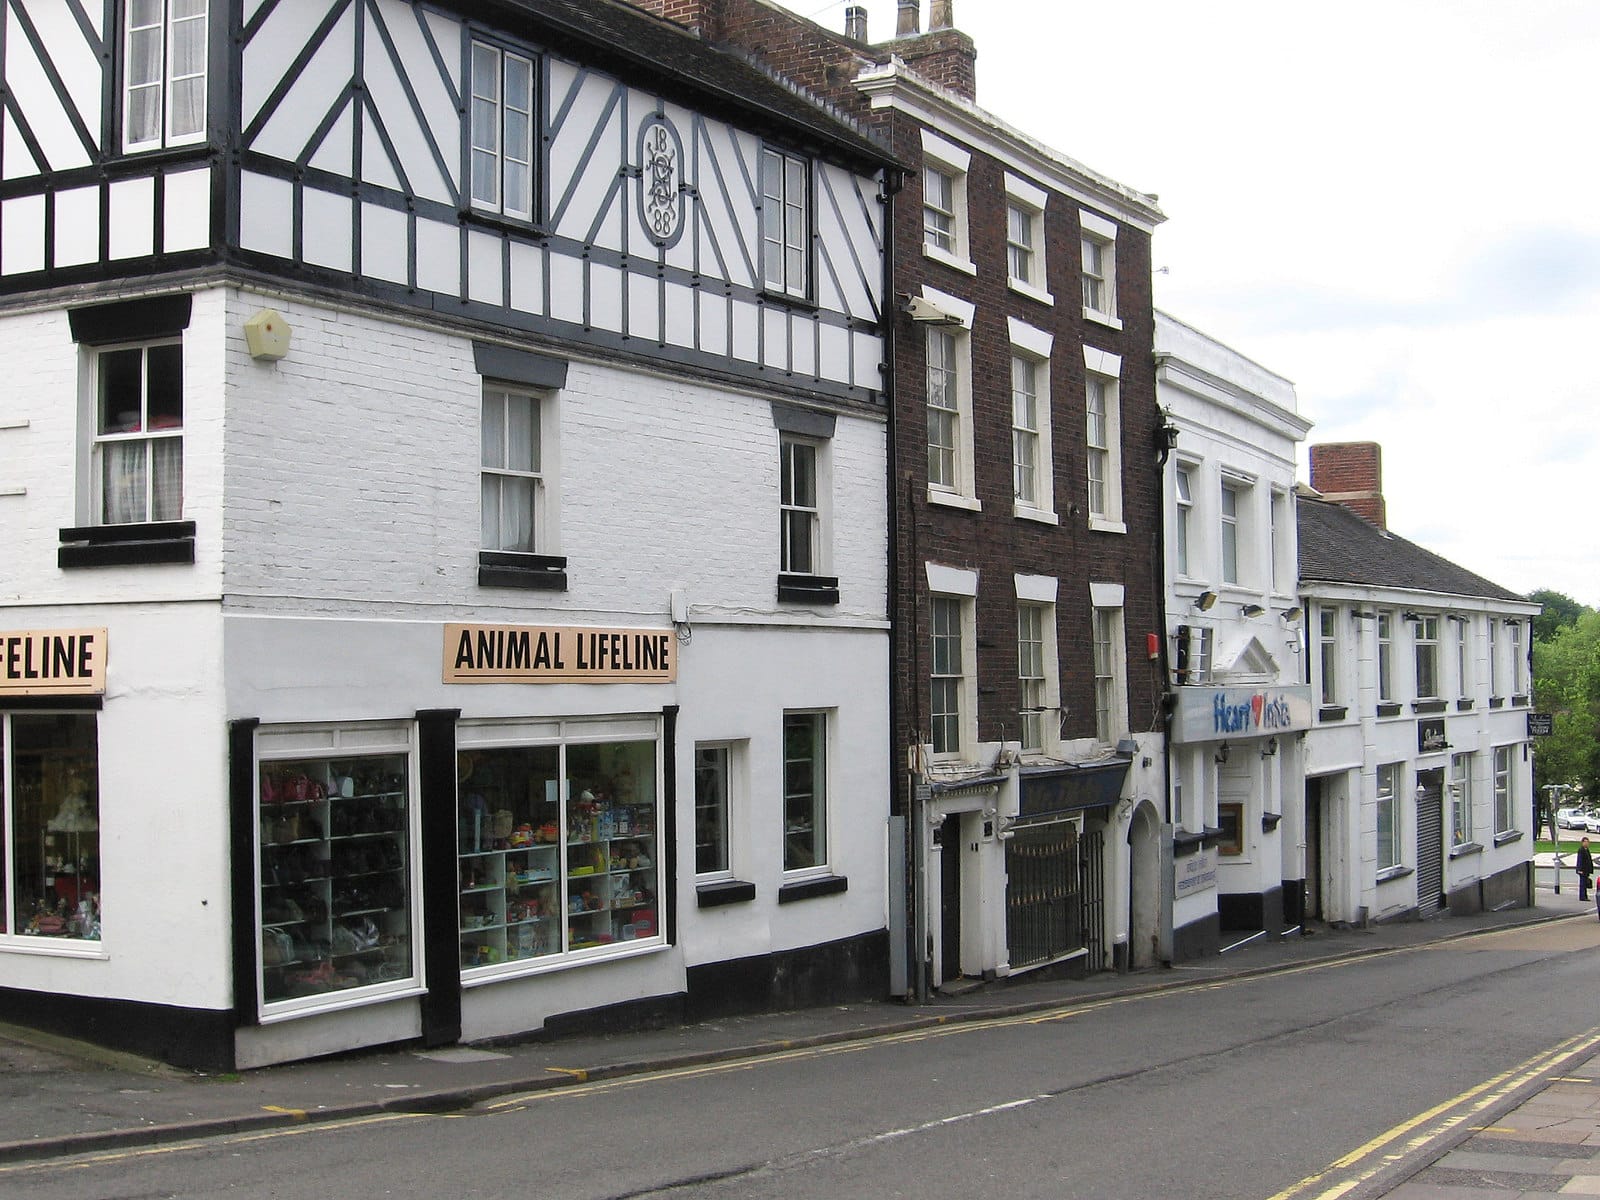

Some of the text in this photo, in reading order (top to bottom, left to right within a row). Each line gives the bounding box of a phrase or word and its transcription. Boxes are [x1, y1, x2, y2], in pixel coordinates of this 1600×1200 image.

[654, 126, 667, 152] 18
[654, 209, 671, 235] 88
[0, 635, 94, 679] ELINE
[455, 630, 669, 671] ANIMAL LIFELINE
